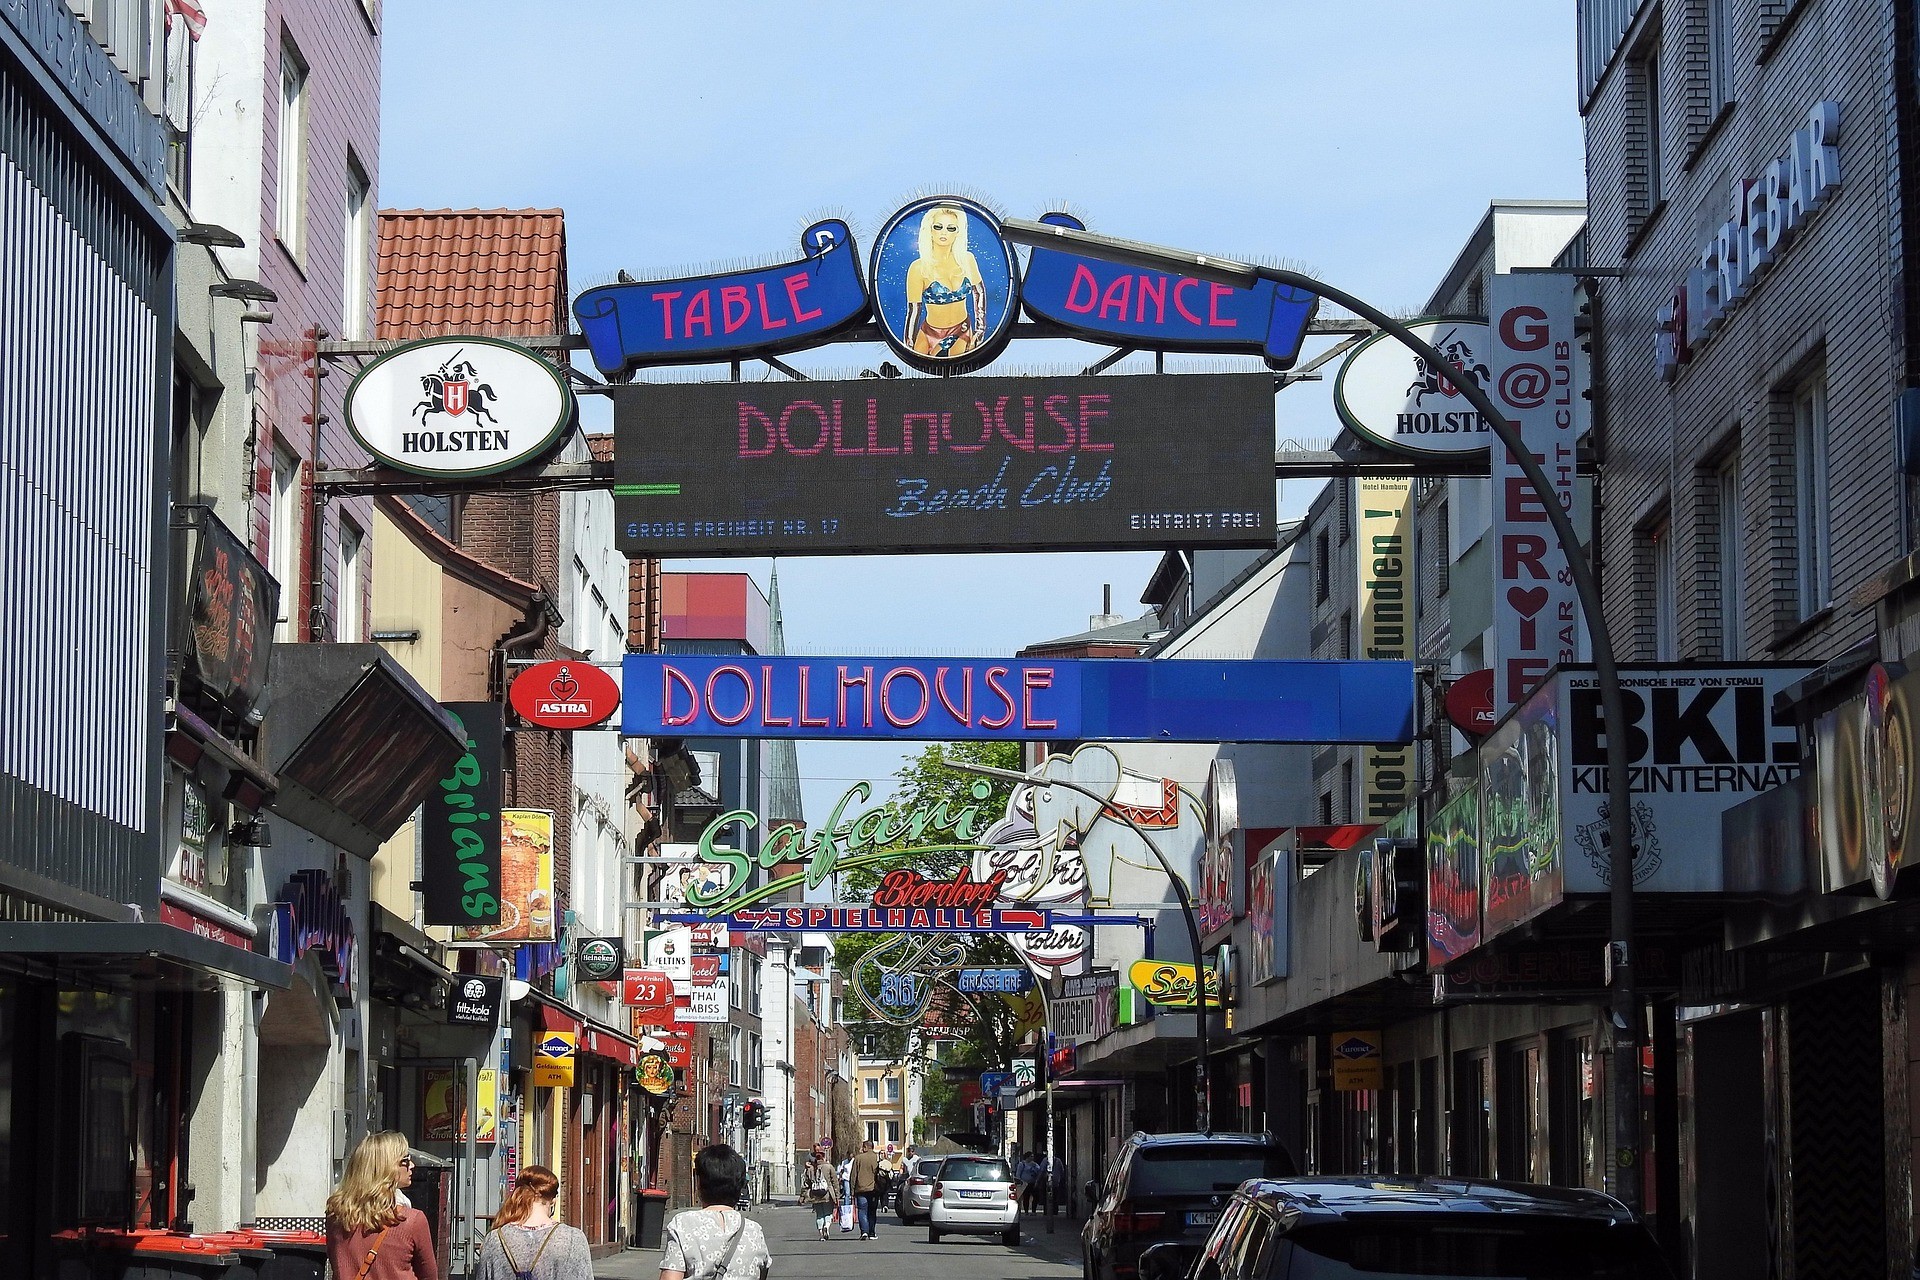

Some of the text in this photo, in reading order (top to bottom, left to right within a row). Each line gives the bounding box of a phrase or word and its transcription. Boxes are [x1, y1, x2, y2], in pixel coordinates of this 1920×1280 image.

[1064, 262, 1238, 328] DANCE
[652, 271, 824, 340] TABLE
[1554, 340, 1571, 430] CLUB
[402, 430, 510, 453] HOLSTEN
[1020, 455, 1112, 508] Club
[1362, 483, 1408, 491] Hotel Hamburg
[693, 519, 775, 537] FREIHEIT
[821, 519, 839, 535] 17
[1130, 512, 1261, 530] EINTRITT FREI
[1558, 600, 1574, 664] BAR
[1569, 679, 1589, 688] DAS
[1670, 677, 1696, 687] HERZ
[1698, 677, 1722, 687] VON
[661, 663, 1058, 731] DOLLHOUSE
[540, 703, 587, 713] ASTRA
[685, 778, 992, 907] Safari
[785, 907, 993, 929] SPIELHALLE
[1024, 929, 1085, 951] Colibri
[583, 954, 614, 962] Heineken
[634, 983, 657, 1001] 23
[692, 991, 716, 1002] THAI
[882, 973, 915, 1006] 36
[542, 1043, 569, 1053] Euronet
[1340, 1045, 1370, 1053] Euronet
[535, 1063, 573, 1071] Geldautomat
[547, 1073, 562, 1081] ATM
[1191, 1213, 1199, 1224] K
